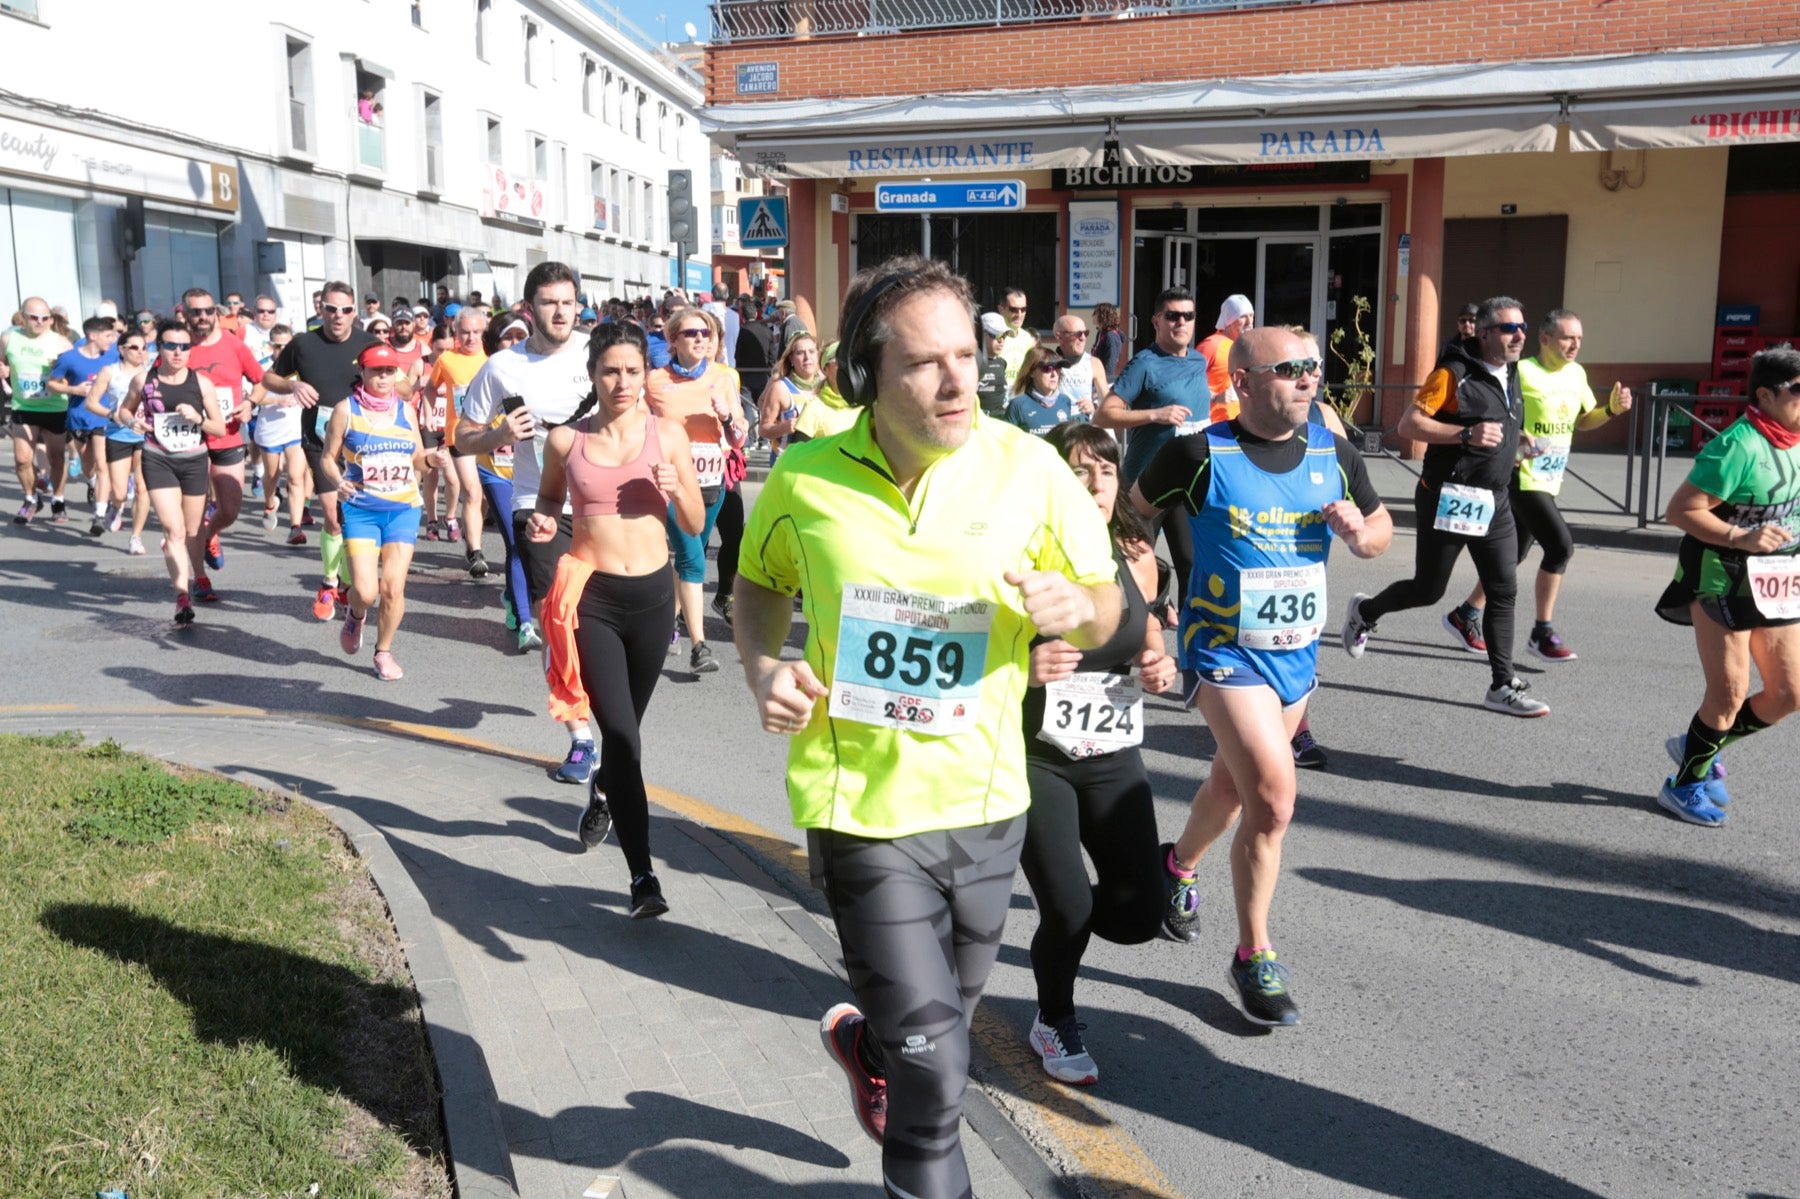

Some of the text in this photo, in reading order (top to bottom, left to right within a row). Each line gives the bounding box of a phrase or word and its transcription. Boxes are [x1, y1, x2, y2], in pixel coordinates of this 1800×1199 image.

[747, 64, 776, 72] AVENIDA
[749, 72, 774, 82] JACOBO
[740, 82, 777, 92] CAMARERO
[1260, 128, 1386, 156] PARADA
[848, 141, 1034, 171] RESTAURANTE
[218, 171, 233, 201] B
[1065, 165, 1194, 186] BICHITOS
[880, 191, 937, 204] Granada
[1080, 224, 1111, 232] PARADA
[162, 423, 198, 438] 3154
[366, 465, 411, 481] 2127
[692, 457, 723, 473] 011
[1257, 507, 1325, 528] olimpo
[1447, 499, 1485, 521] 241
[1255, 526, 1300, 536] deportes
[1266, 570, 1282, 579] GRAN
[1755, 575, 1800, 598] 2015
[854, 587, 881, 603] XXXIII
[883, 591, 909, 606] GRAN
[911, 595, 945, 613] PREMIO
[1257, 592, 1317, 624] 436
[864, 631, 964, 690] 859
[1056, 699, 1134, 735] 3124
